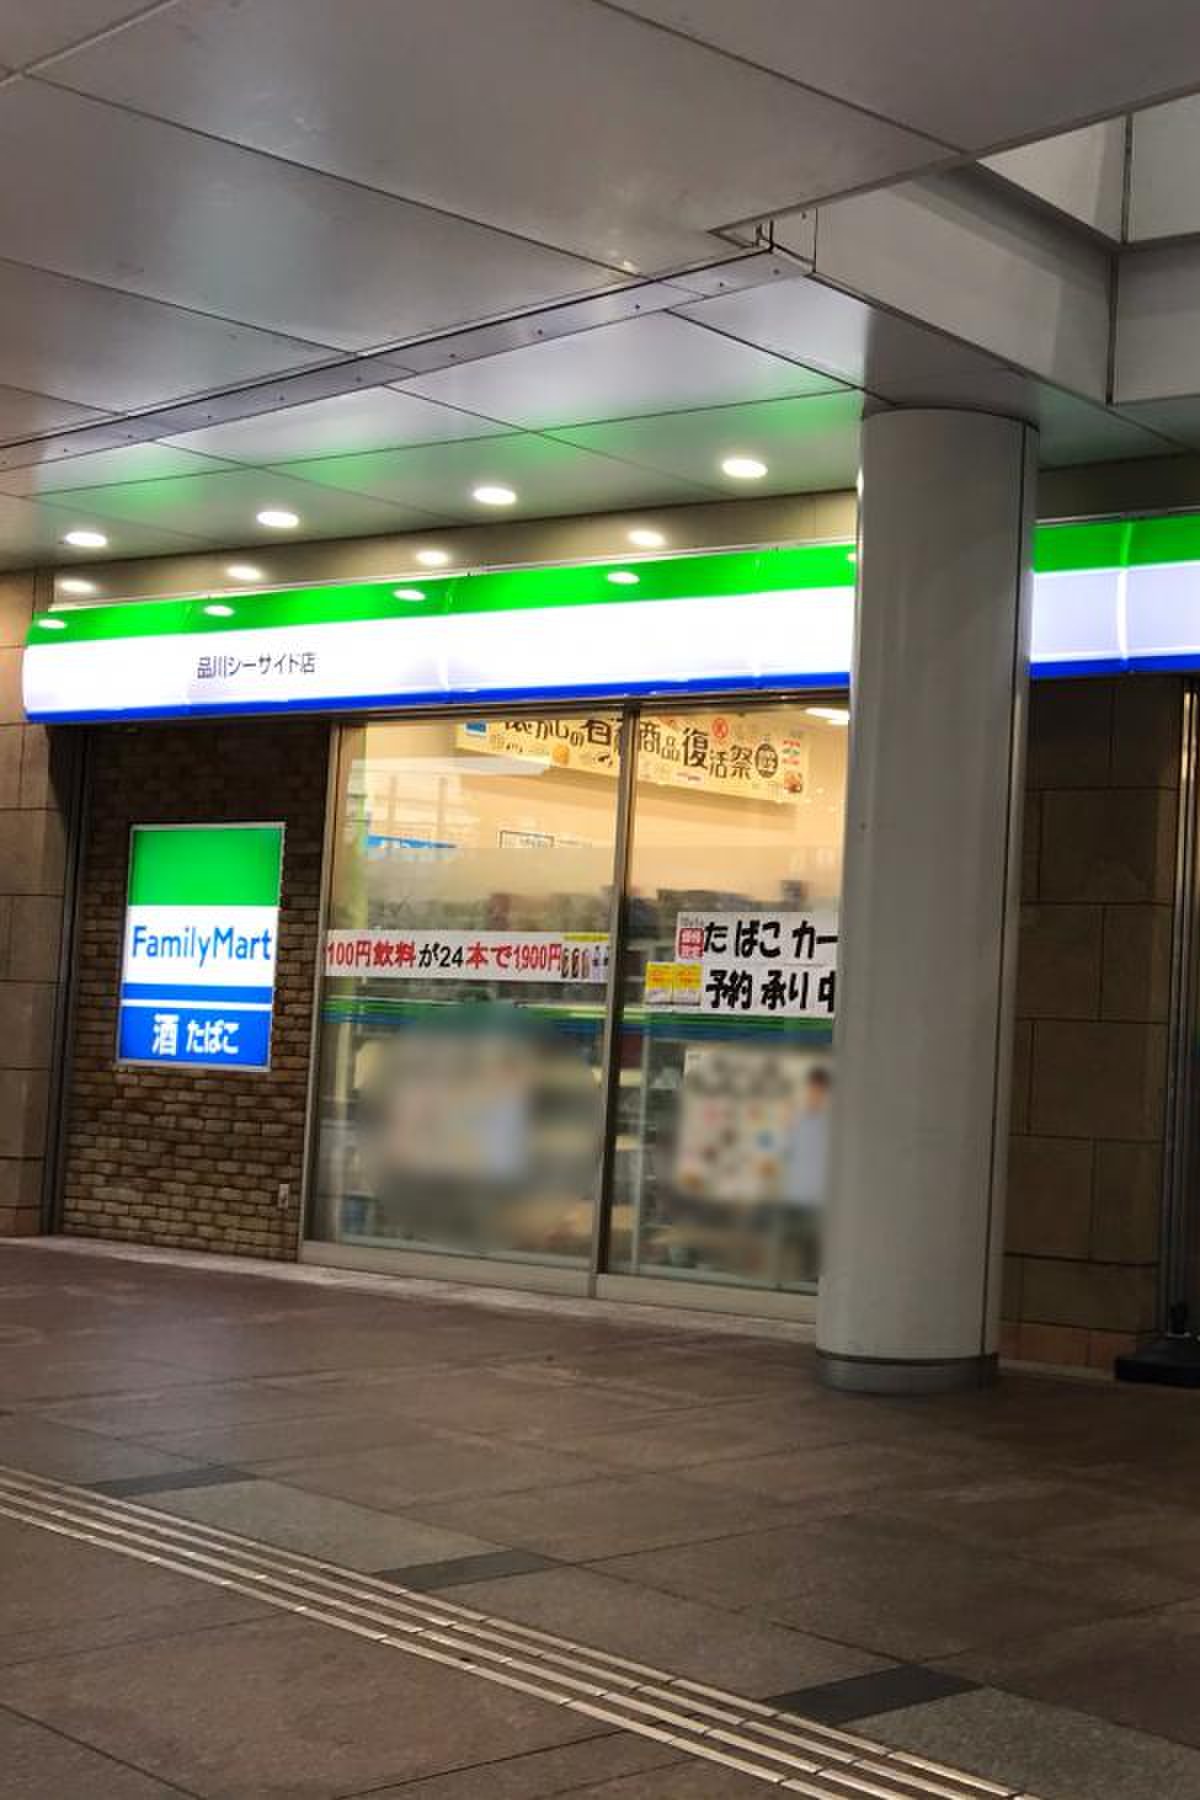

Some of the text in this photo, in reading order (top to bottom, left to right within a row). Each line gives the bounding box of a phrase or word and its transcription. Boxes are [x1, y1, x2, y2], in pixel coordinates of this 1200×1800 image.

[197, 651, 317, 679] 品川シーサイド店
[132, 924, 272, 968] FamilyMart
[152, 1013, 240, 1056] 酒 たばこ
